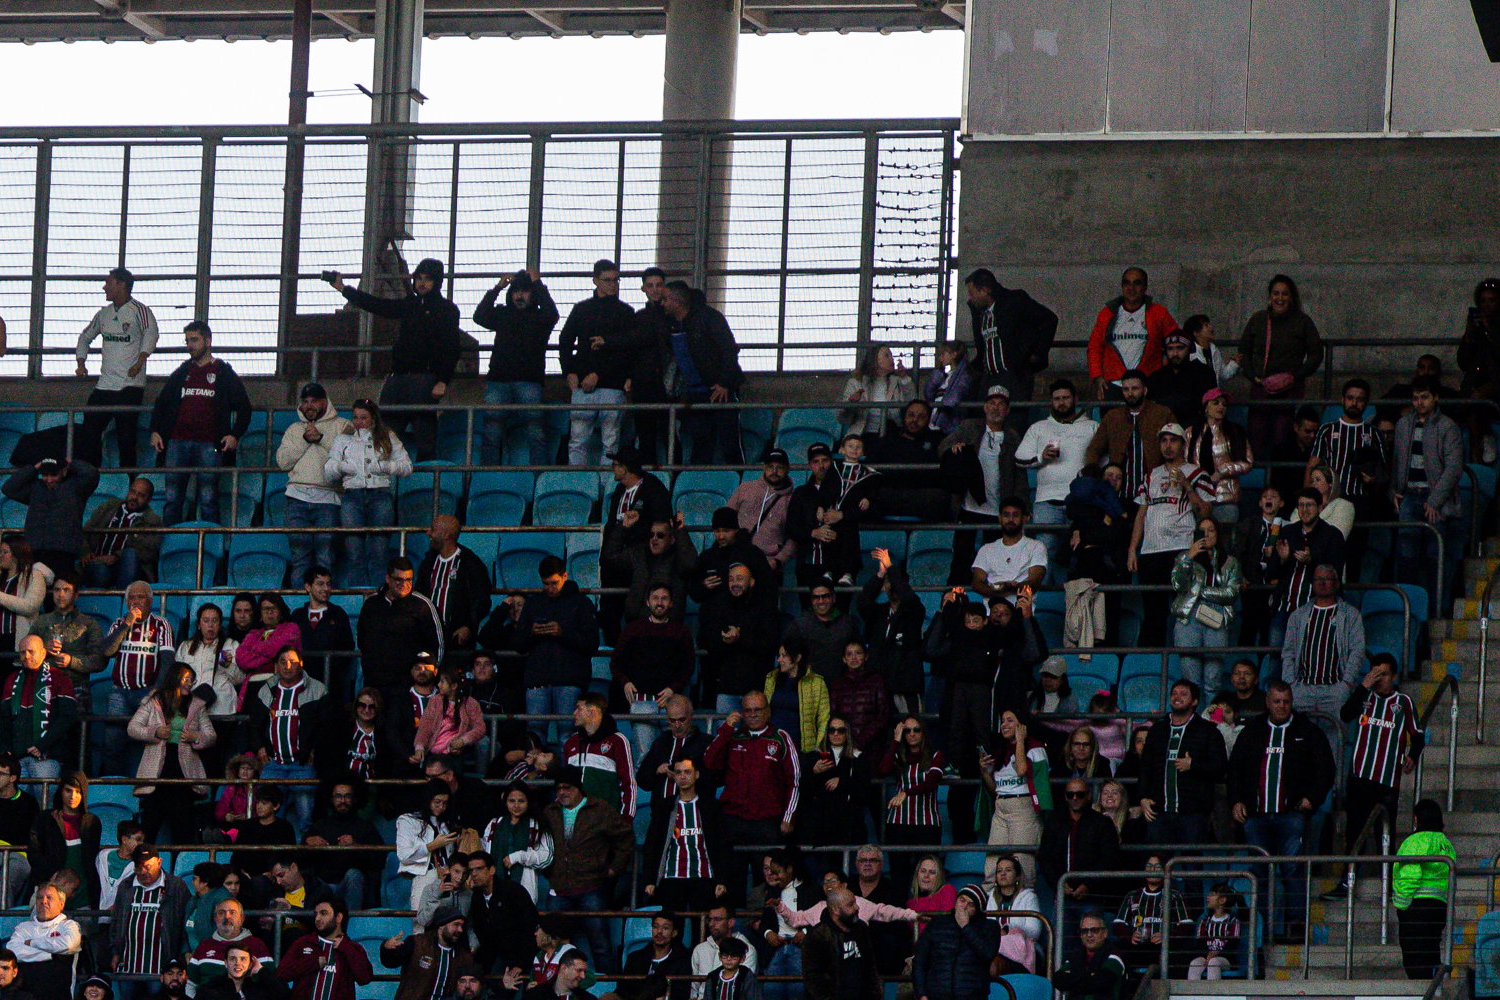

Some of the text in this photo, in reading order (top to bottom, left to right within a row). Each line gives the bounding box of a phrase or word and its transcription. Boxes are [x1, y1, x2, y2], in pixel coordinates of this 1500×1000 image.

[186, 387, 216, 398] BETANO
[121, 644, 157, 655] nimed
[276, 709, 299, 717] BETAN
[1368, 715, 1396, 729] BETANO
[680, 828, 703, 837] BETAN
